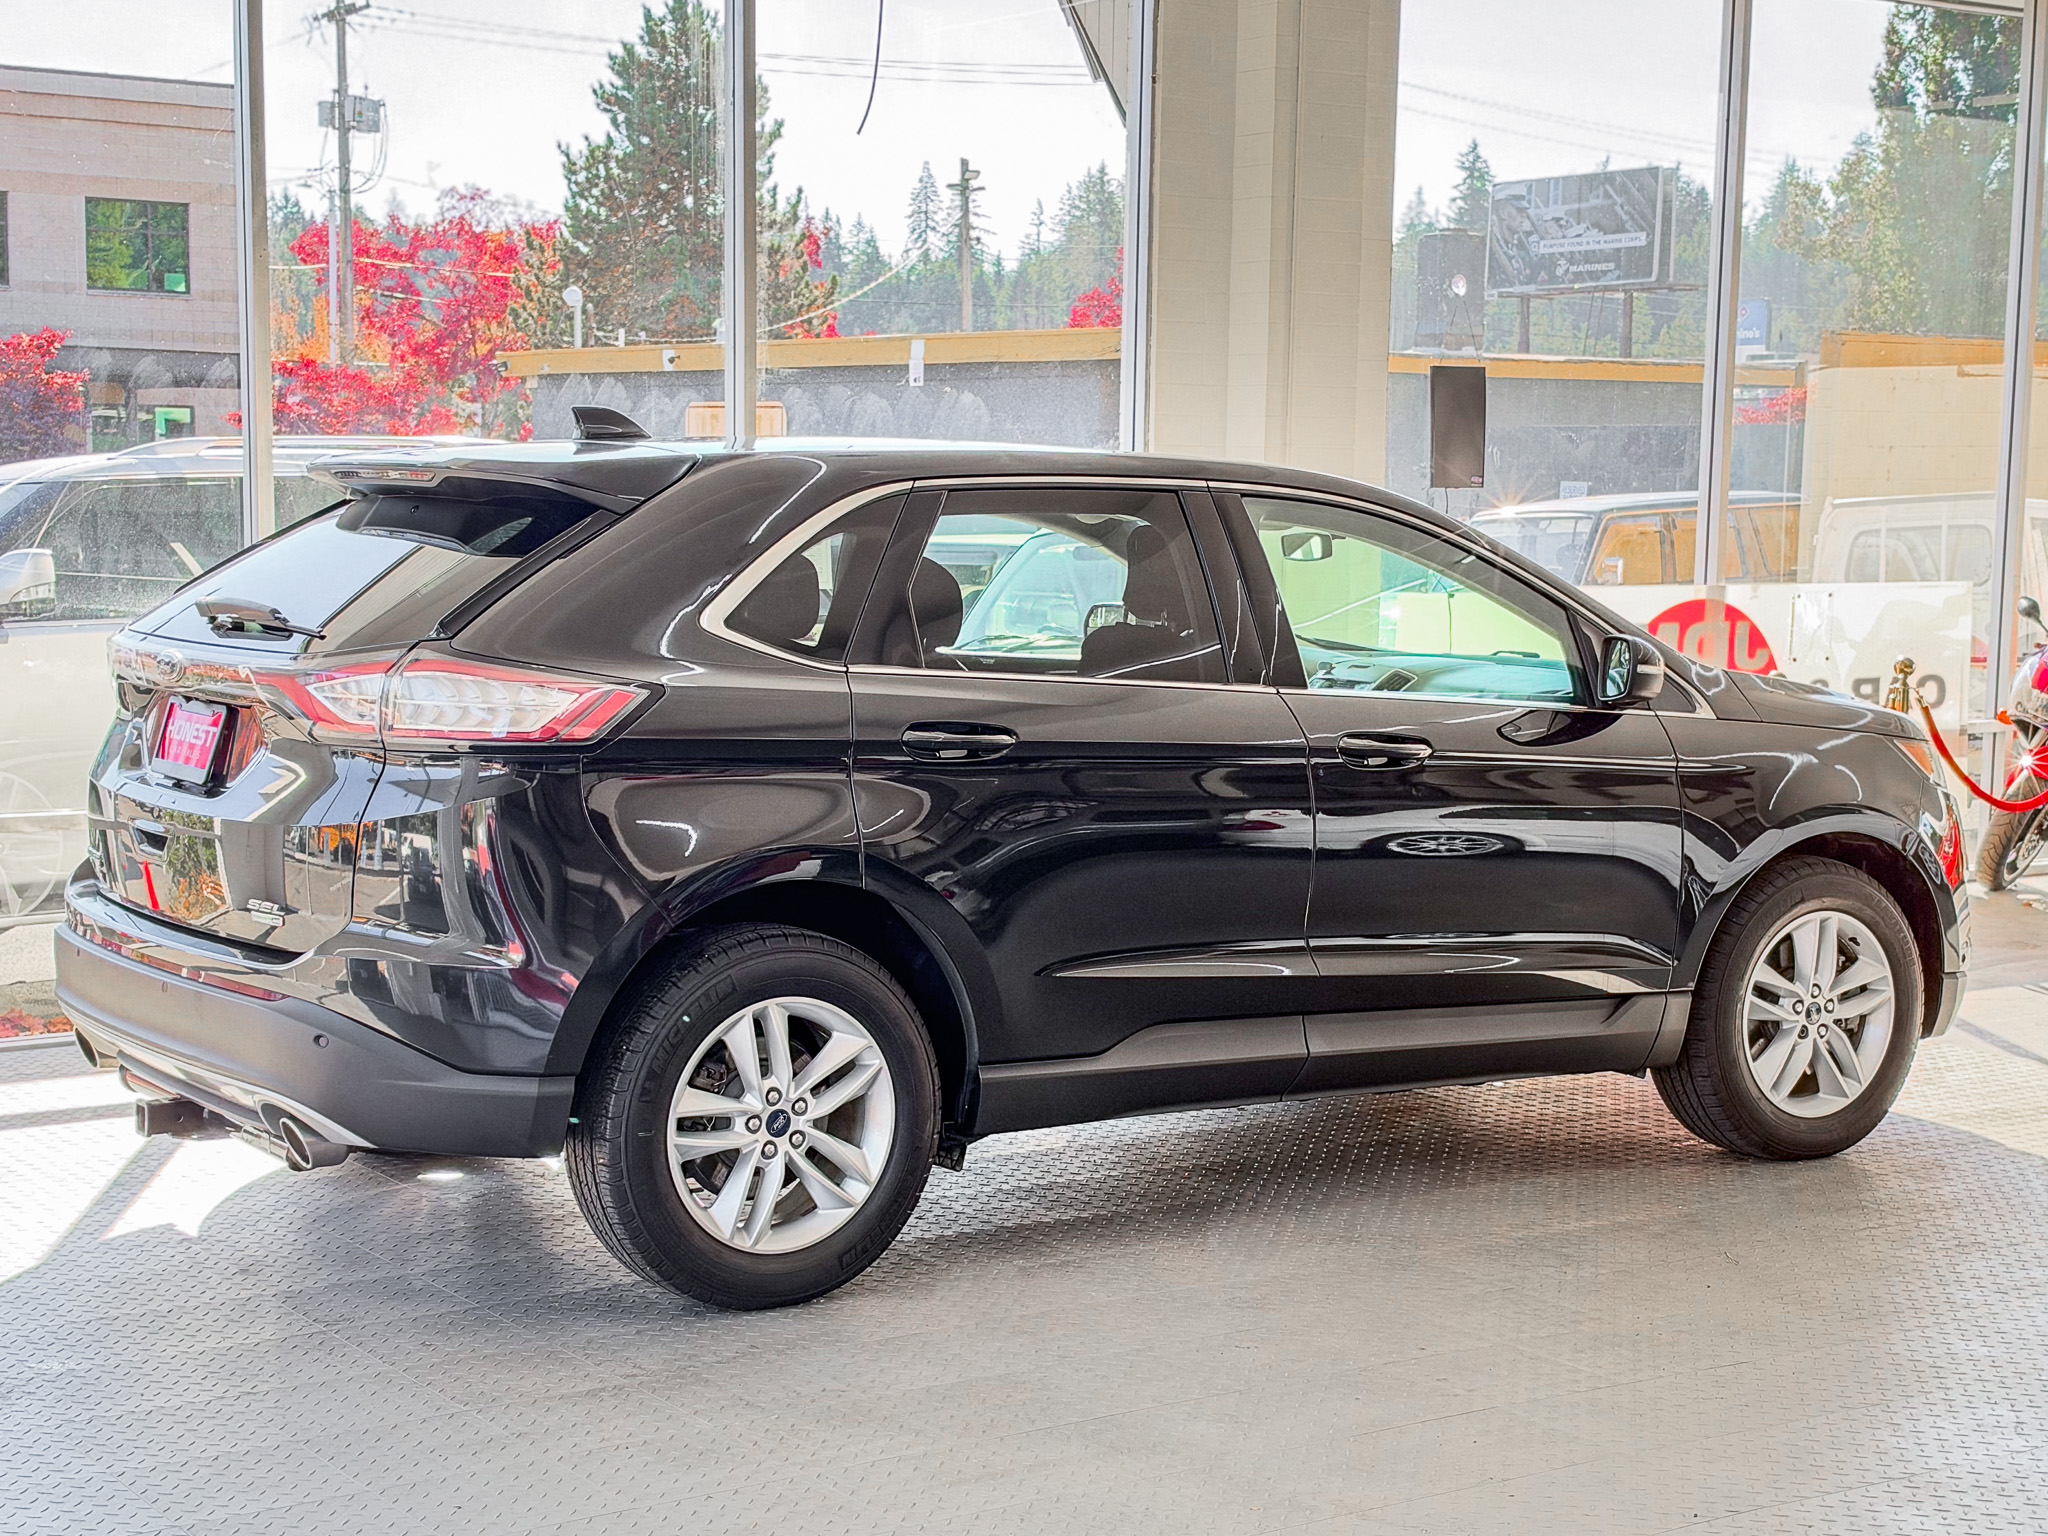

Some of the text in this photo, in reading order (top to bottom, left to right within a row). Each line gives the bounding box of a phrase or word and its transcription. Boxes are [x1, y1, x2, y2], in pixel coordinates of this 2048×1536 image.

[1603, 237, 1622, 245] MARINE
[1624, 236, 1641, 244] CORPS
[1569, 262, 1615, 273] MARINES
[166, 718, 218, 747] HONEST
[246, 898, 286, 915] SEL
